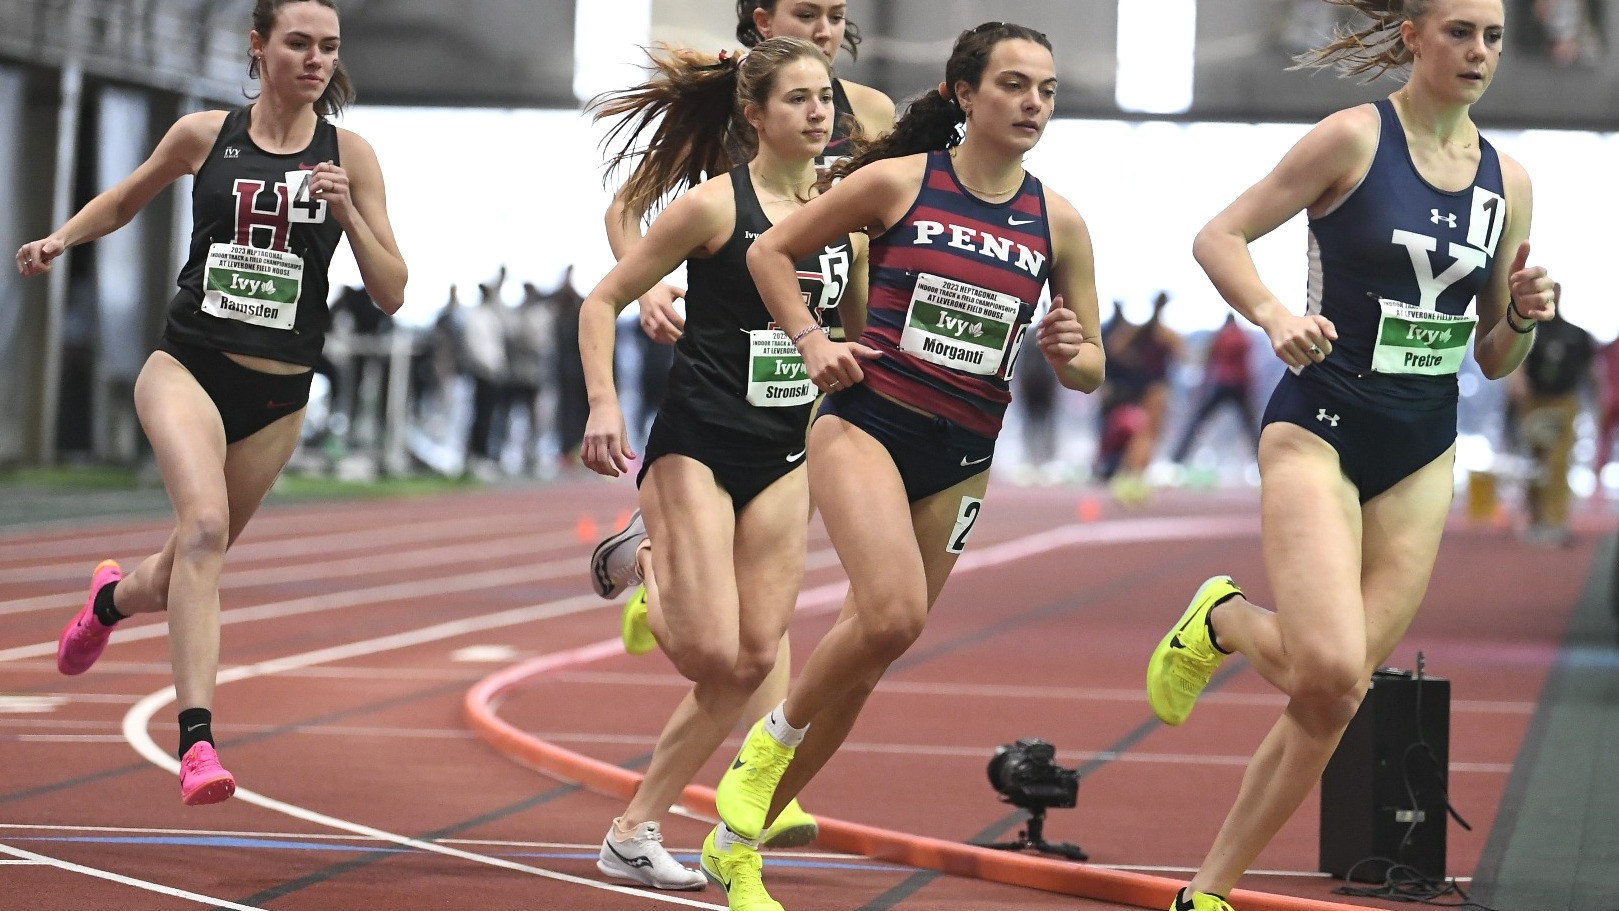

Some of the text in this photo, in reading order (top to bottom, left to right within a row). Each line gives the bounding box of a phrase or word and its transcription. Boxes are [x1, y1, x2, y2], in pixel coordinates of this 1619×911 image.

[293, 173, 321, 219] 4
[230, 178, 292, 253] H
[1482, 196, 1498, 249] 1
[231, 246, 283, 260] 2023 HEPTAGONAL
[912, 220, 1046, 277] PENN
[210, 252, 228, 260] INDOOR
[228, 253, 244, 261] TRACK
[249, 256, 263, 264] FIELD
[263, 258, 302, 270] CHAMPIONSHIPS
[228, 261, 255, 271] LEVERONE
[256, 264, 272, 273] FIELD
[272, 268, 290, 277] HOUSE
[1391, 229, 1487, 310] Y
[230, 273, 262, 295] Ivy
[827, 256, 844, 306] 5
[942, 281, 998, 301] 2023 HEPTAGONAL
[220, 295, 279, 319] Ramsden
[917, 283, 939, 294] INDOOR
[939, 288, 956, 299] TRACK
[961, 295, 975, 303] FIELD
[975, 298, 1017, 314] CHAMPIONSHIPS
[936, 295, 966, 310] LEVERONE
[967, 304, 983, 314] FIELD
[983, 307, 1004, 320] HOUSE
[935, 310, 970, 336] Ivy
[1404, 310, 1435, 320] LEVERONE
[1406, 323, 1440, 345] Ivy
[922, 336, 984, 365] Morganti
[1404, 352, 1443, 367] Pretre
[774, 359, 801, 379] Ivy
[766, 382, 810, 399] Stronski
[951, 501, 981, 551] 2
